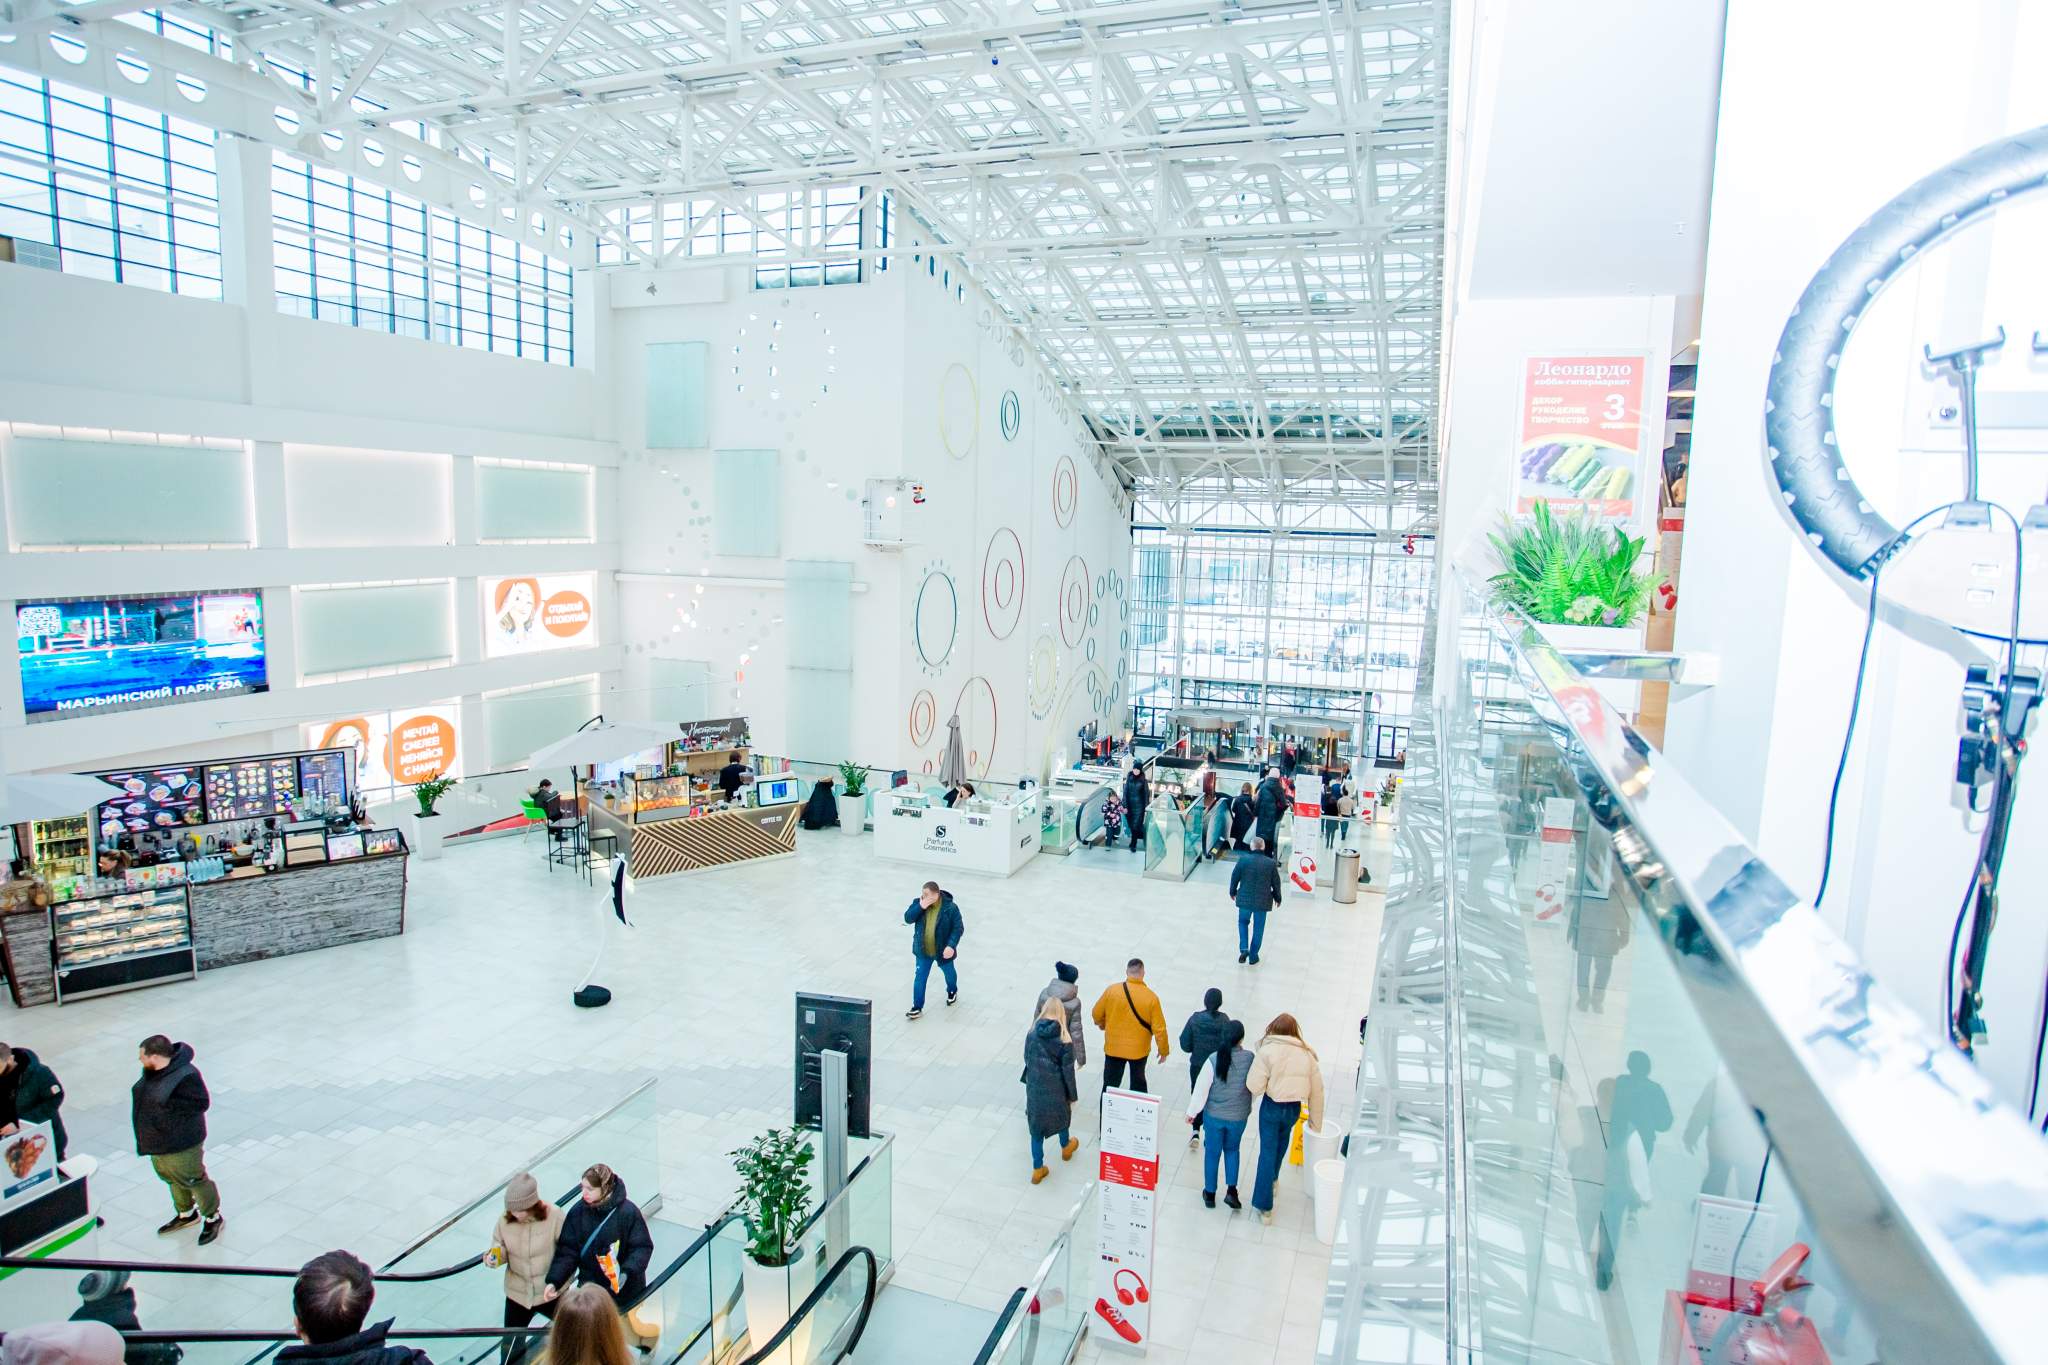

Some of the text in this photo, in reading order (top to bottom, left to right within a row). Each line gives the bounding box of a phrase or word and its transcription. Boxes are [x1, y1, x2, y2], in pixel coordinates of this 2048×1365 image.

[1534, 361, 1632, 379] Леонардо
[1532, 397, 1563, 405] ДЕКОР
[1532, 406, 1587, 415] РУКОДЕЛИЕ
[1602, 393, 1625, 421] 3
[1531, 416, 1590, 424] ТВОРЧЕСТВО
[548, 601, 583, 614] ОТДЫХАЙ
[57, 688, 172, 711] МАРЬИНСКИЙ
[174, 682, 215, 697] ПАРК
[403, 722, 439, 739] МЕЧТАЙ
[400, 747, 443, 765] МЕНЯЙСЯ
[403, 767, 411, 776] С
[1159, 783, 1182, 794] BAR
[923, 843, 957, 854] Cosmetics
[1105, 1156, 1111, 1164] 3
